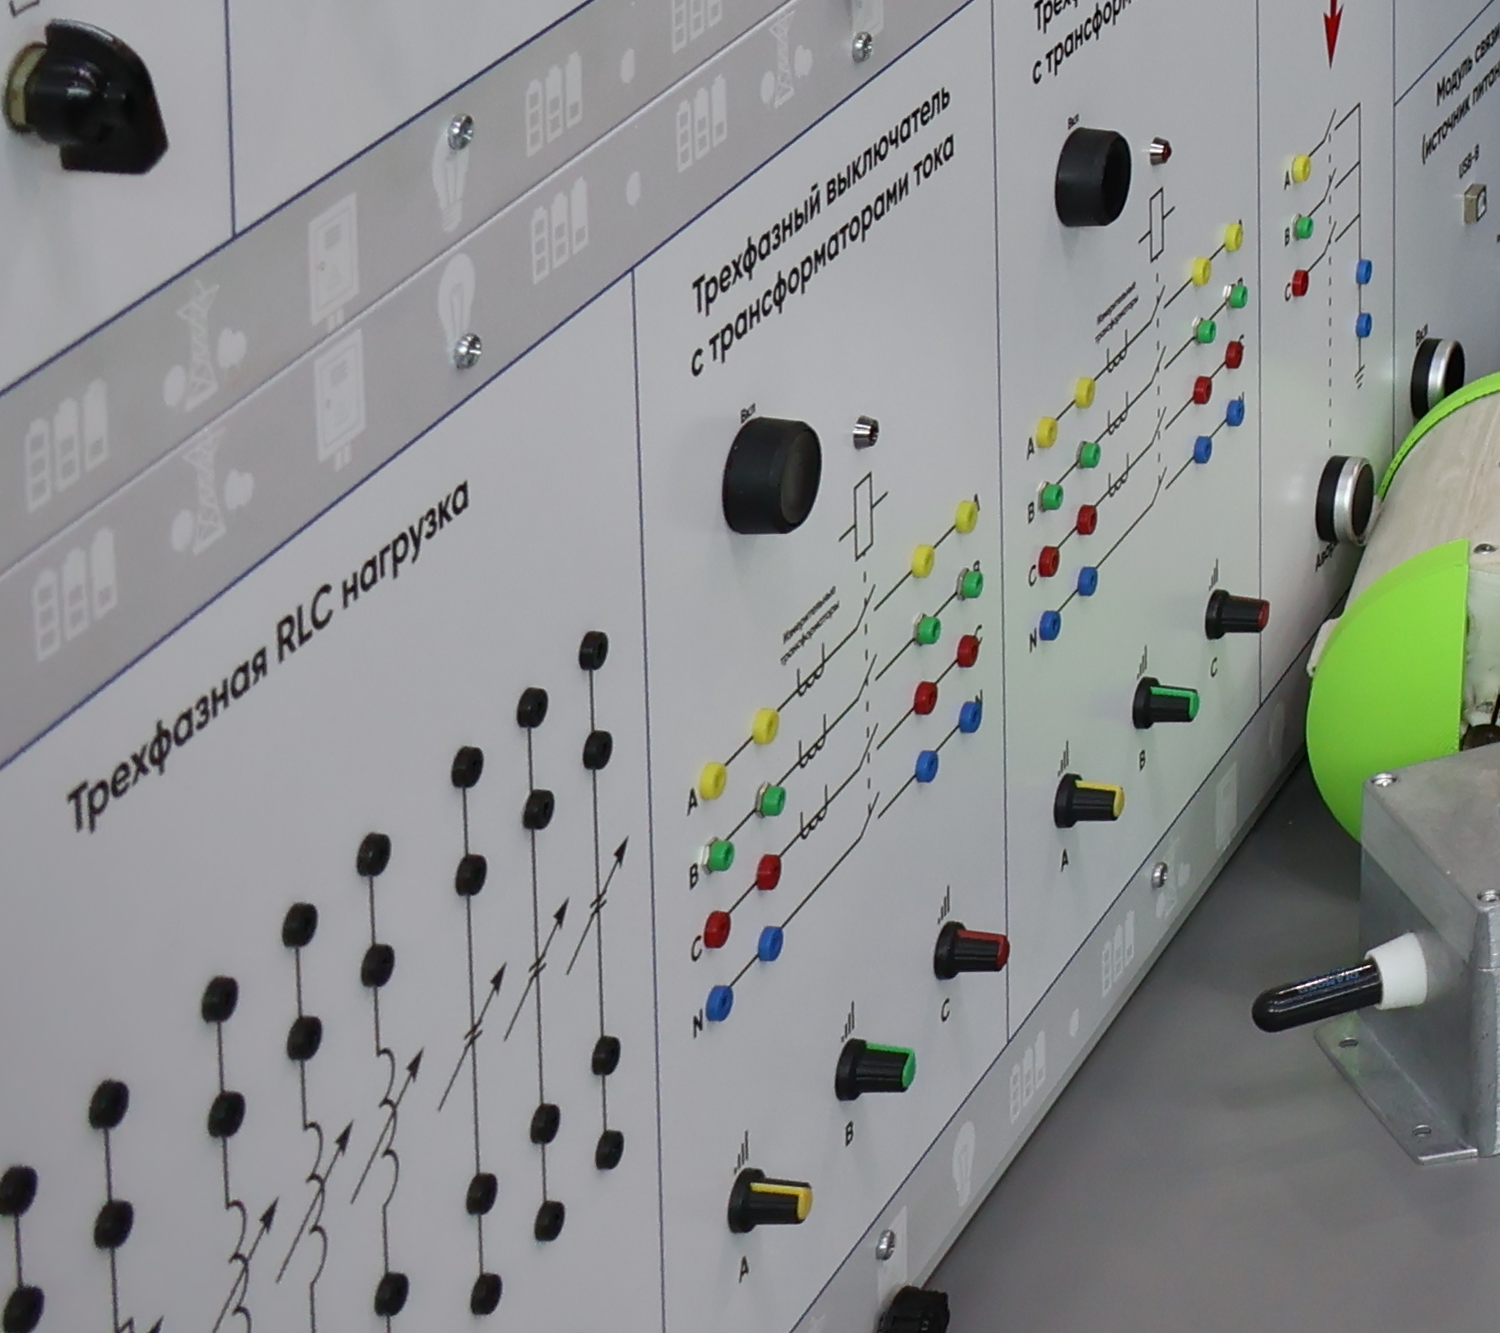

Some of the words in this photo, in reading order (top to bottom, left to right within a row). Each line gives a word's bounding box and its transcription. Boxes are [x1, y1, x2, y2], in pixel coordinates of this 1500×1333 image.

[1032, 61, 1043, 84] с
[1436, 55, 1473, 106] Модуль
[1474, 23, 1500, 64] связи
[1421, 95, 1471, 165] (источник
[1458, 144, 1480, 179] USB-B
[1284, 171, 1291, 191] A
[691, 181, 822, 314] Трехфазный
[826, 84, 951, 204] выключатель
[1284, 227, 1291, 246] B
[690, 346, 704, 376] с
[708, 180, 911, 362] трансформаторами
[914, 131, 955, 189] тока
[1284, 282, 1292, 302] C
[1026, 438, 1035, 460] A
[1027, 502, 1035, 523] B
[1028, 565, 1037, 587] C
[1029, 629, 1037, 652] N
[67, 645, 269, 833] Трехфазная
[276, 582, 335, 666] RLC
[341, 479, 470, 610] нагрузка
[1210, 657, 1218, 677] C
[1138, 749, 1146, 770] B
[688, 789, 698, 815] A
[1060, 849, 1069, 872] A
[689, 863, 699, 889] B
[691, 936, 702, 962] C
[940, 998, 950, 1022] C
[693, 1015, 704, 1038] N
[845, 1122, 854, 1146] B
[739, 1255, 749, 1283] A
